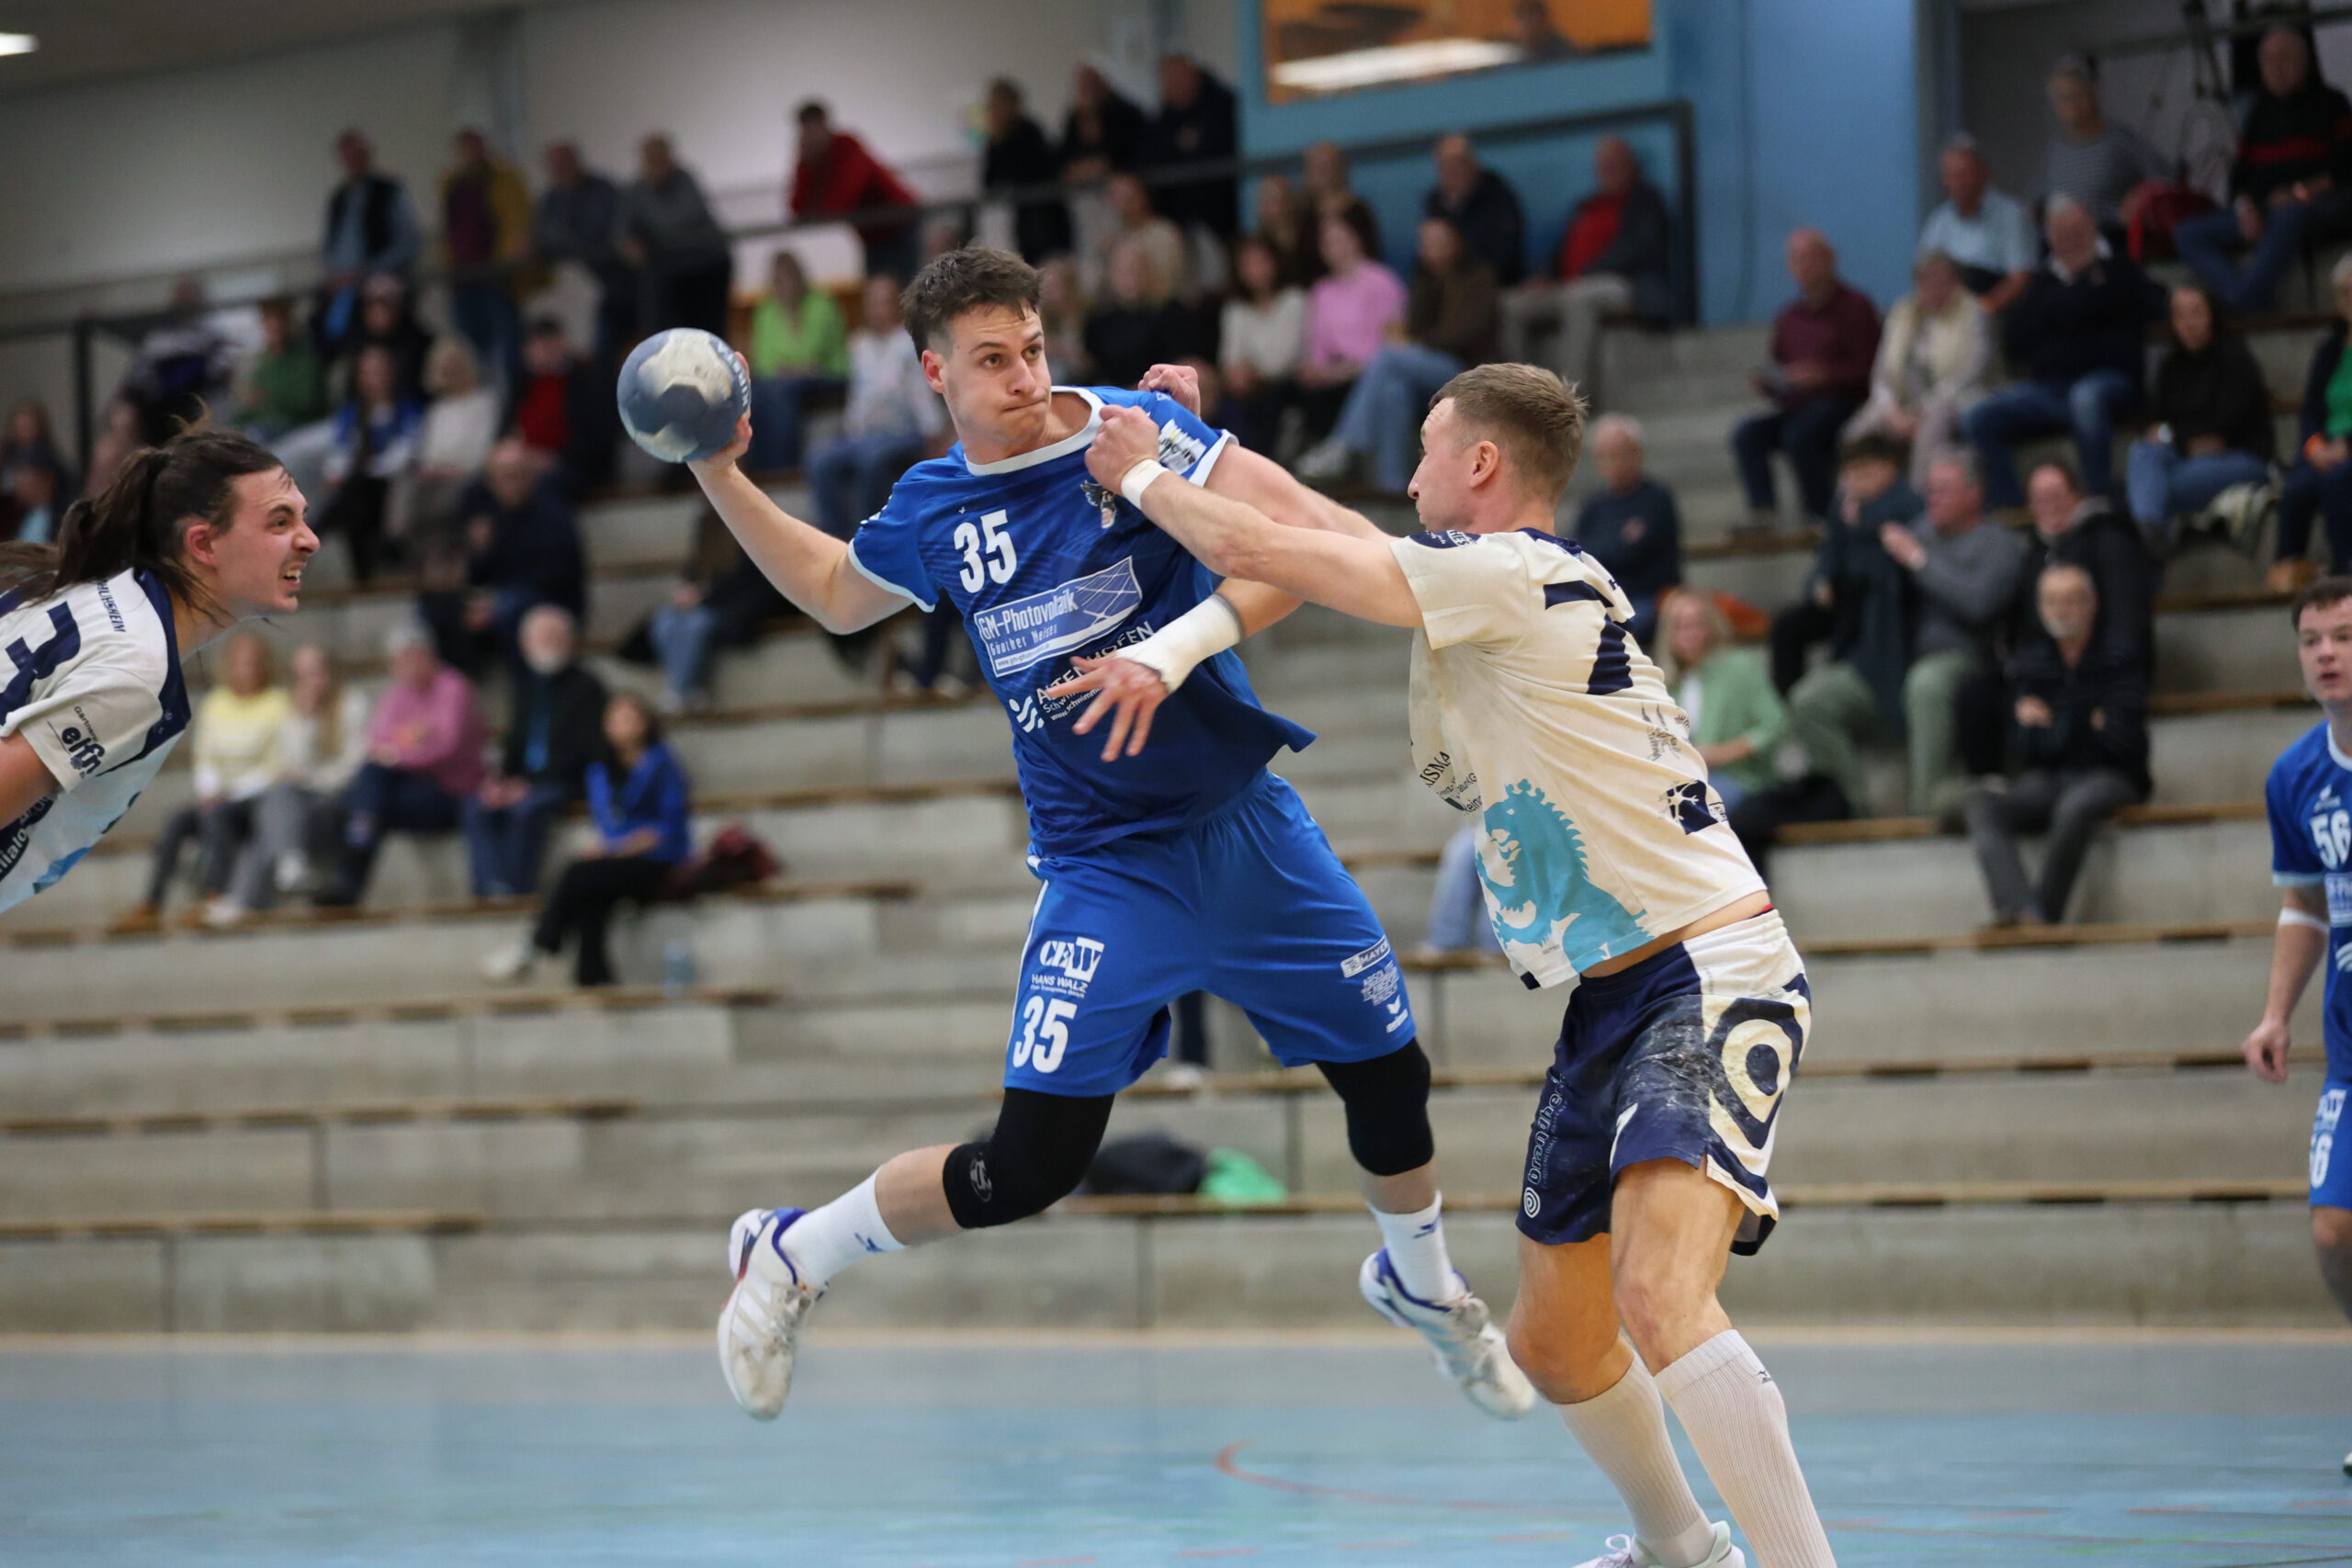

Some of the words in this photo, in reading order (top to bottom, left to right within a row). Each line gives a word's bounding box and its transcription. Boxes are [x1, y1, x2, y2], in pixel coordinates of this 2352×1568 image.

[954, 509, 1018, 593] 35
[1419, 750, 1452, 789] ISMA
[2310, 809, 2352, 871] 56
[1032, 974, 1056, 986] HANS
[1057, 976, 1088, 993] WALZ
[1012, 995, 1078, 1073] 35
